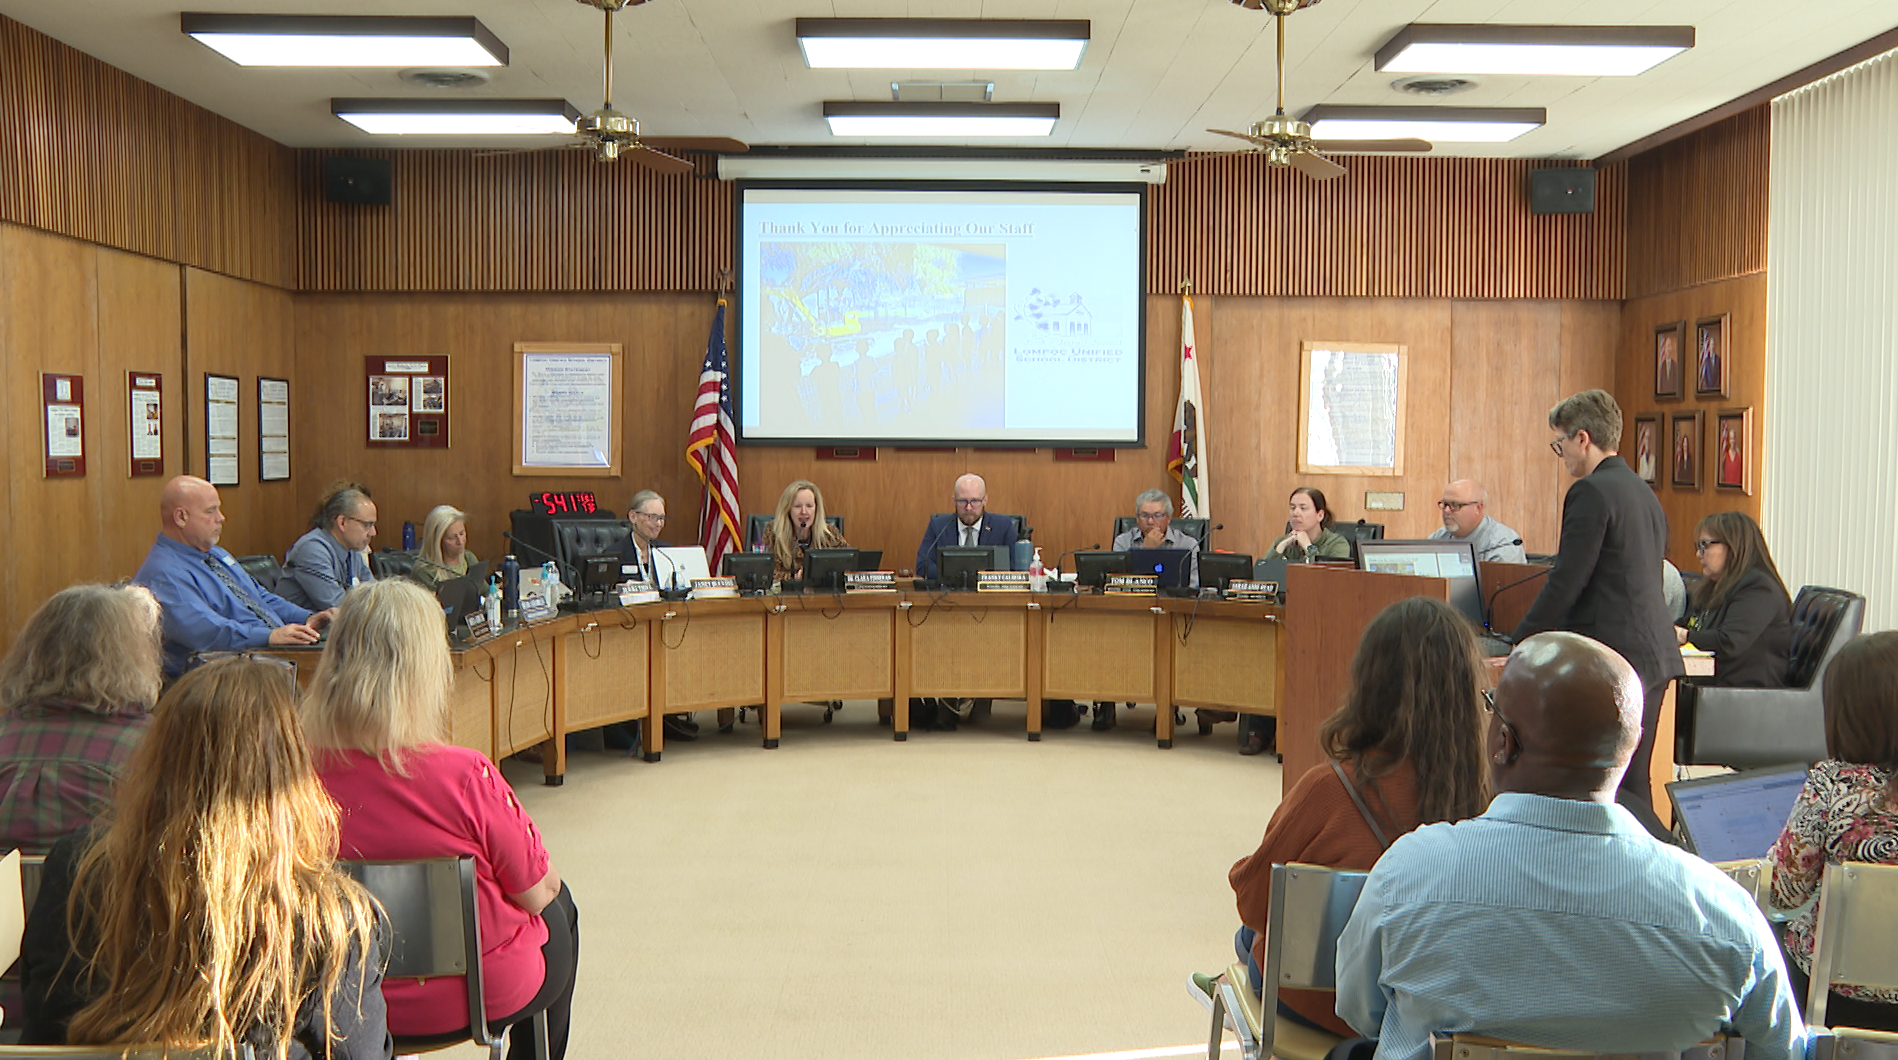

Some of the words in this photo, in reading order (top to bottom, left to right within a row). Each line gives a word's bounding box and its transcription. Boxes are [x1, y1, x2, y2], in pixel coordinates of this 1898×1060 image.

[759, 221, 805, 234] Thank
[810, 221, 838, 234] You
[843, 221, 864, 234] for
[868, 221, 961, 237] Appreciating
[965, 221, 995, 234] Our
[999, 221, 1035, 234] Staff
